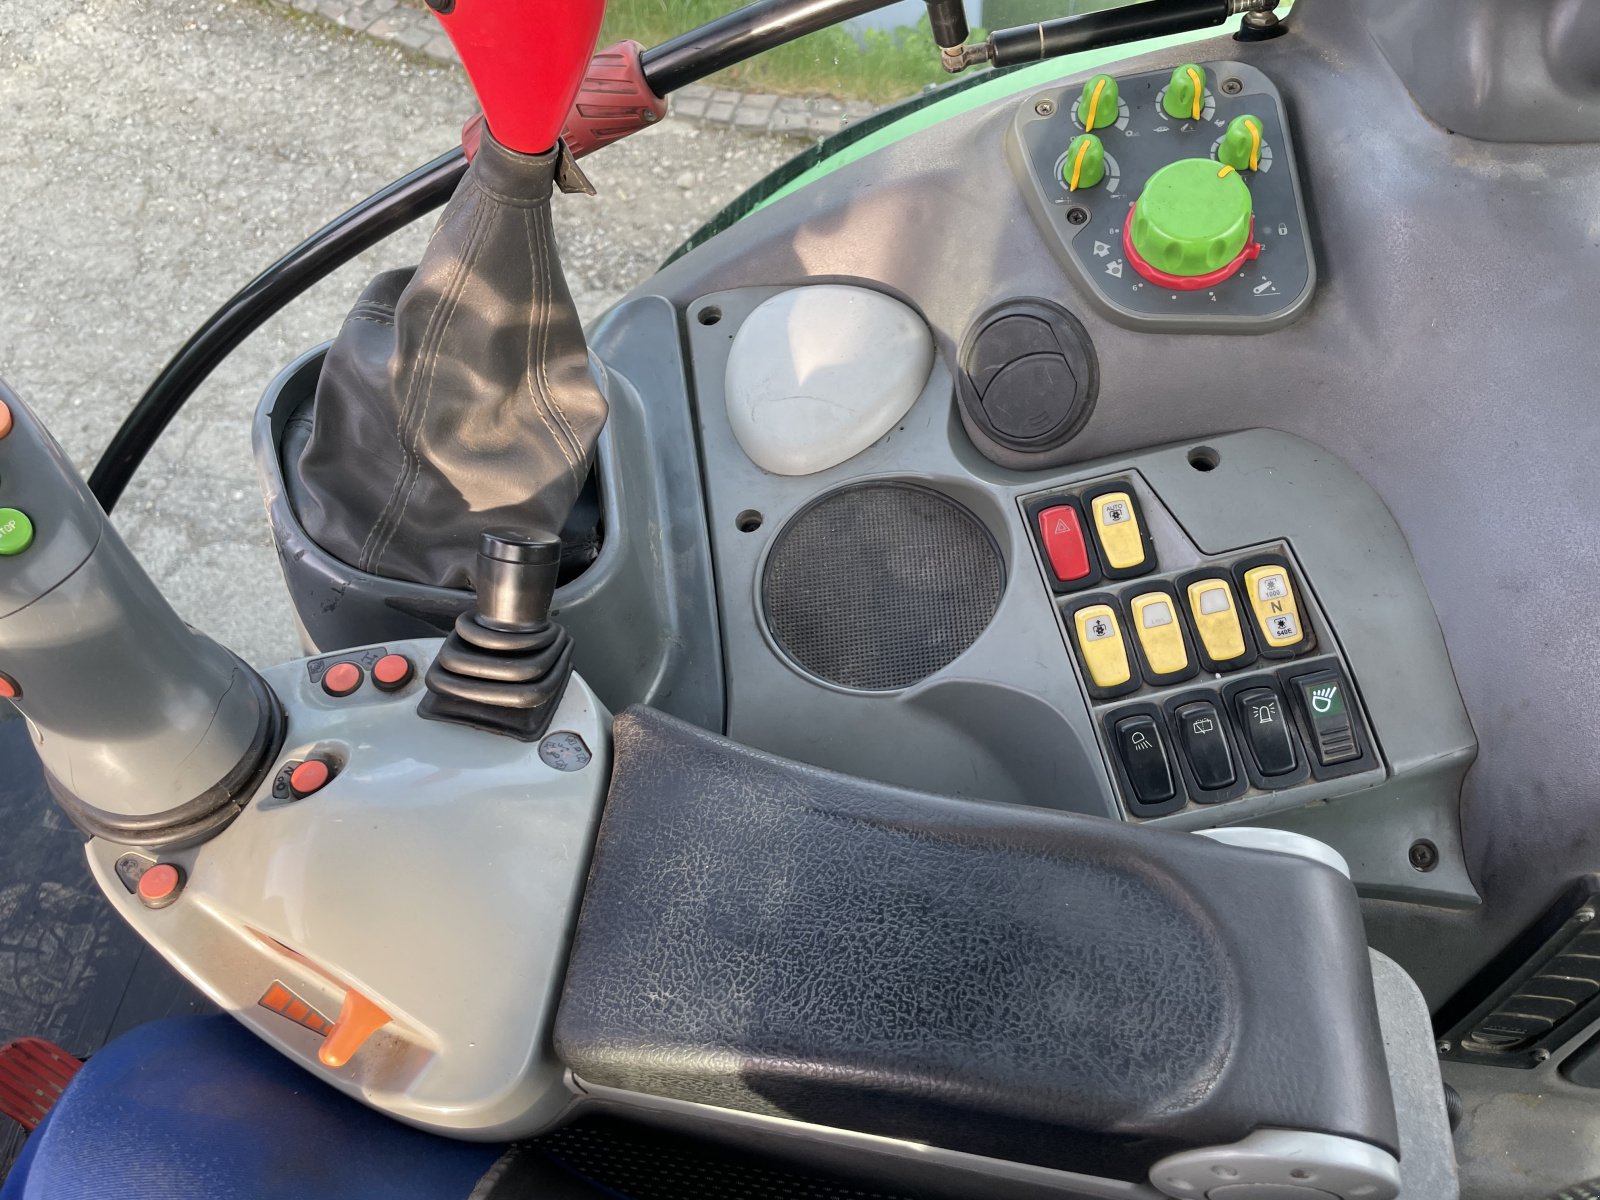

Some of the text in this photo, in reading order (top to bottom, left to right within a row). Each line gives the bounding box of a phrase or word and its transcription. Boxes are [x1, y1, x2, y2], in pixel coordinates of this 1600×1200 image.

[1132, 284, 1138, 292] 6
[1106, 503, 1123, 512] AUTO
[1266, 590, 1281, 598] 1000
[1271, 600, 1283, 614] N
[1277, 628, 1293, 637] 540E
